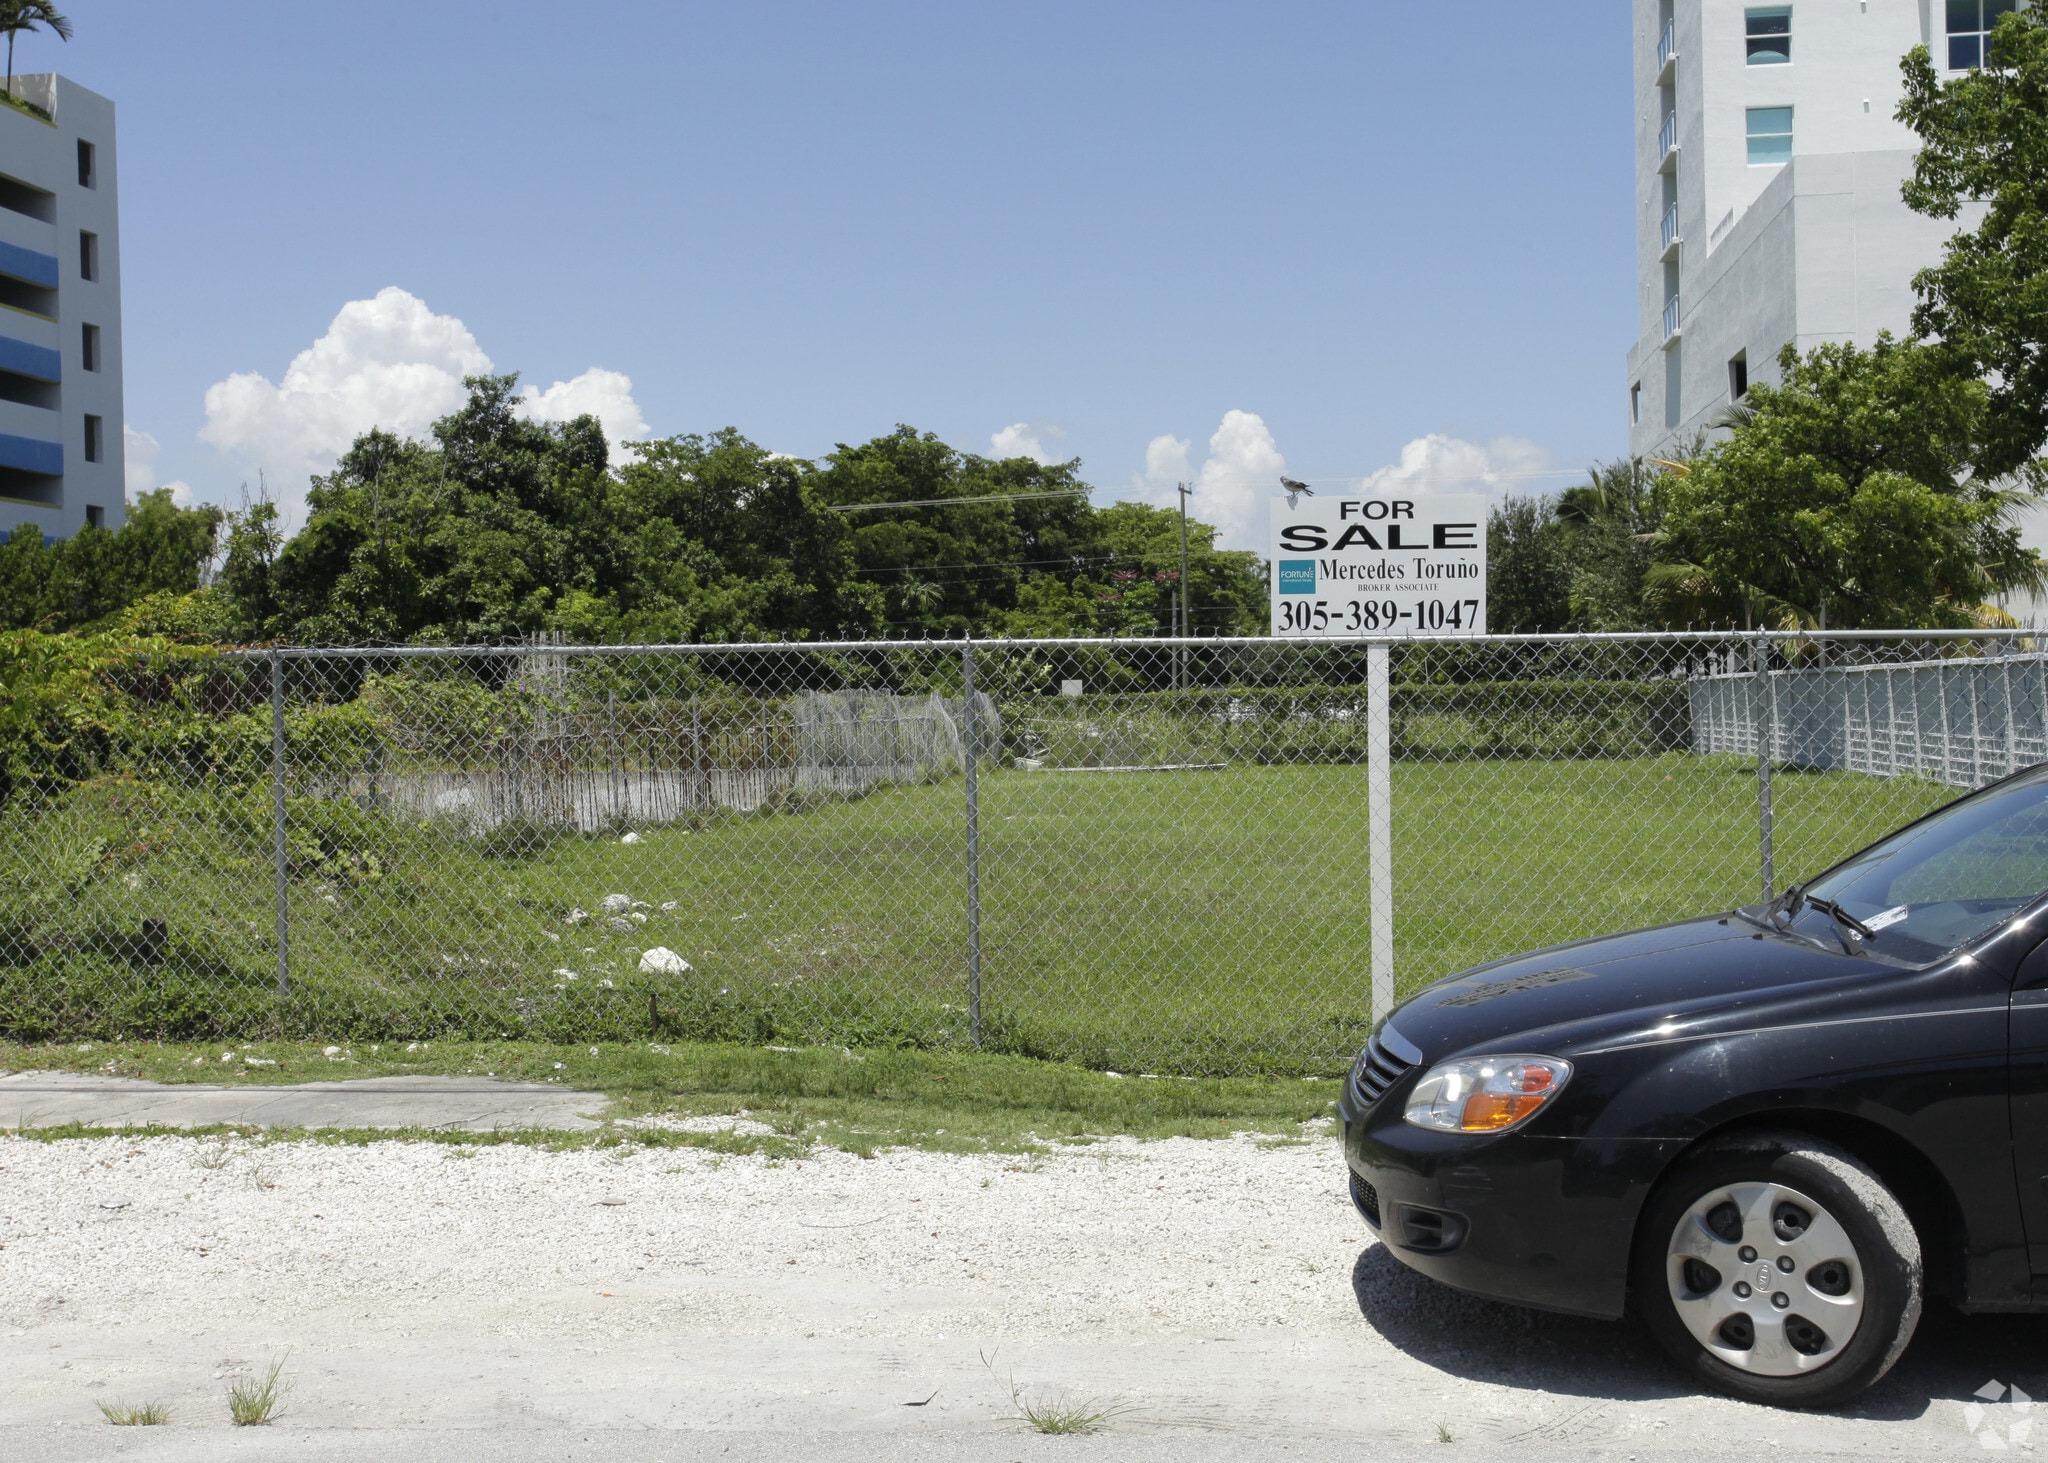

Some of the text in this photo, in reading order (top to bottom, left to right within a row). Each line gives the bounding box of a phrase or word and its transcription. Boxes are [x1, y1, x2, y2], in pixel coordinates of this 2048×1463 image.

[1340, 500, 1415, 520] FOR
[1279, 523, 1477, 551] SALE
[1319, 557, 1479, 580] Mercedes Toruño
[1357, 583, 1440, 592] BROKER ASSOCIATE
[1278, 599, 1480, 631] 305-389-1047
